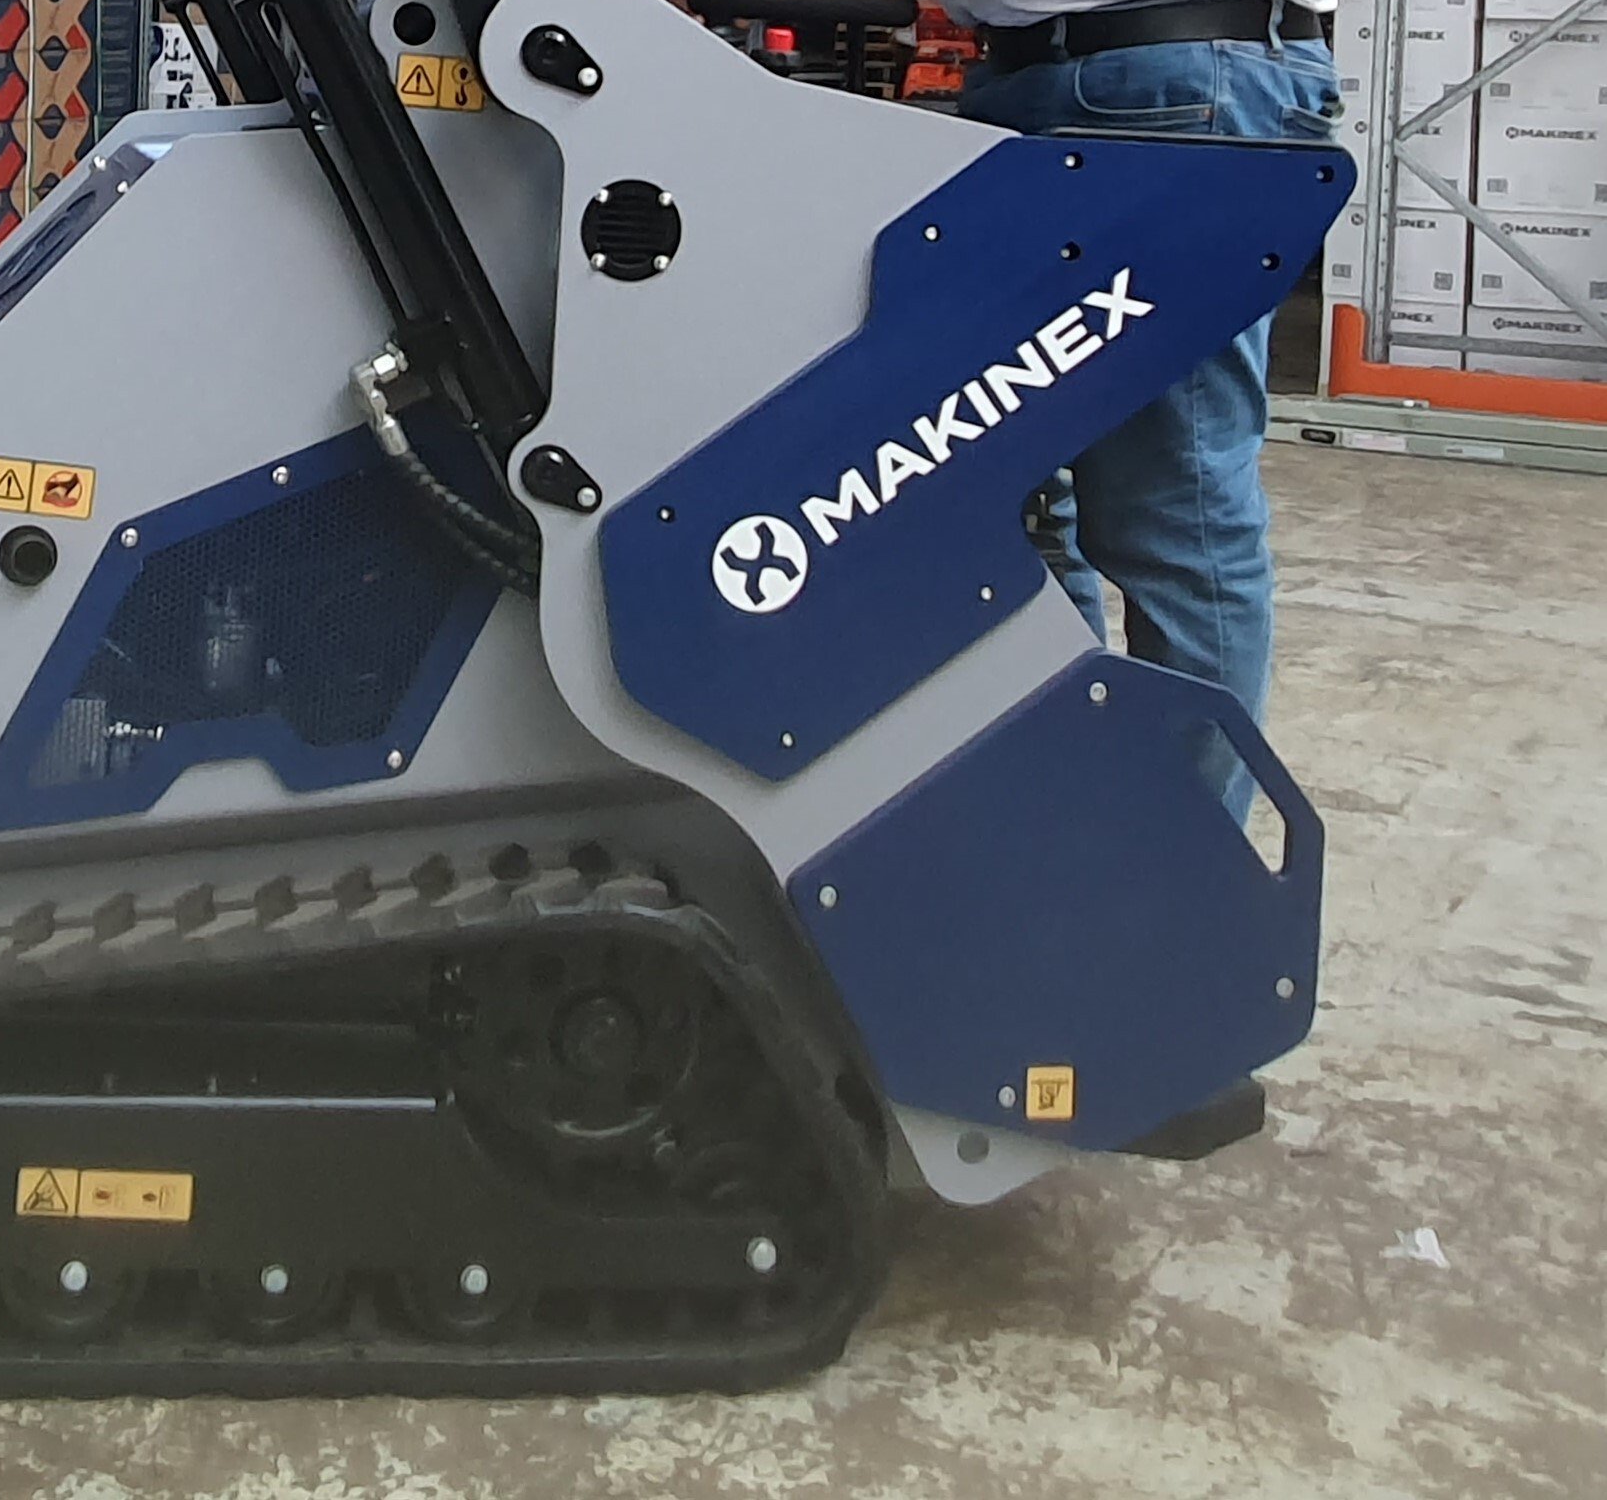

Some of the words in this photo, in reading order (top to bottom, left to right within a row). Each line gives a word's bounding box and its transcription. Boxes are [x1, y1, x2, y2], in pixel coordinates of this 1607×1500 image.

[1520, 128, 1597, 140] MAKINEX
[1515, 225, 1591, 237] MAKINEX
[1505, 321, 1583, 333] MAKINEX
[800, 267, 1155, 546] MAKINEX
